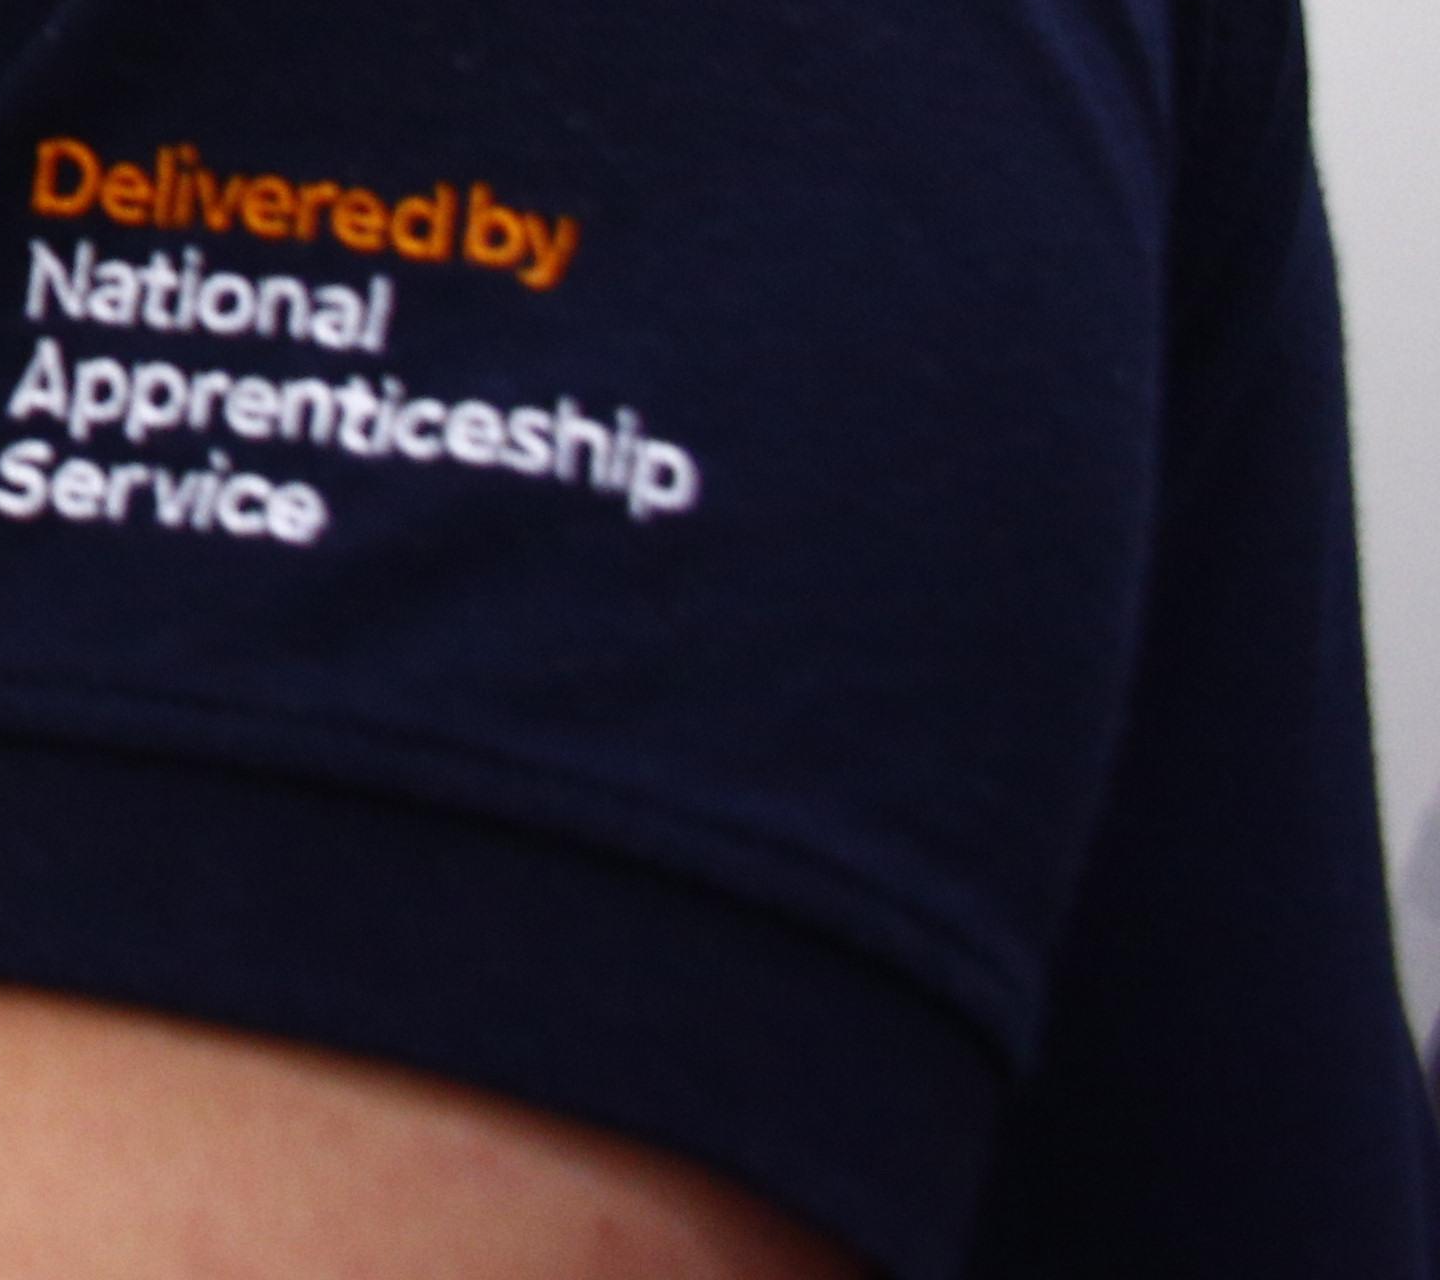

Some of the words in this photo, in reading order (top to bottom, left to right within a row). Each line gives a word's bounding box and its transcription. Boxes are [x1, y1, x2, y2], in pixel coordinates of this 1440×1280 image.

[29, 136, 460, 263] Delivered
[462, 181, 581, 292] by
[23, 239, 394, 353] National
[5, 336, 701, 523] Apprenticeship
